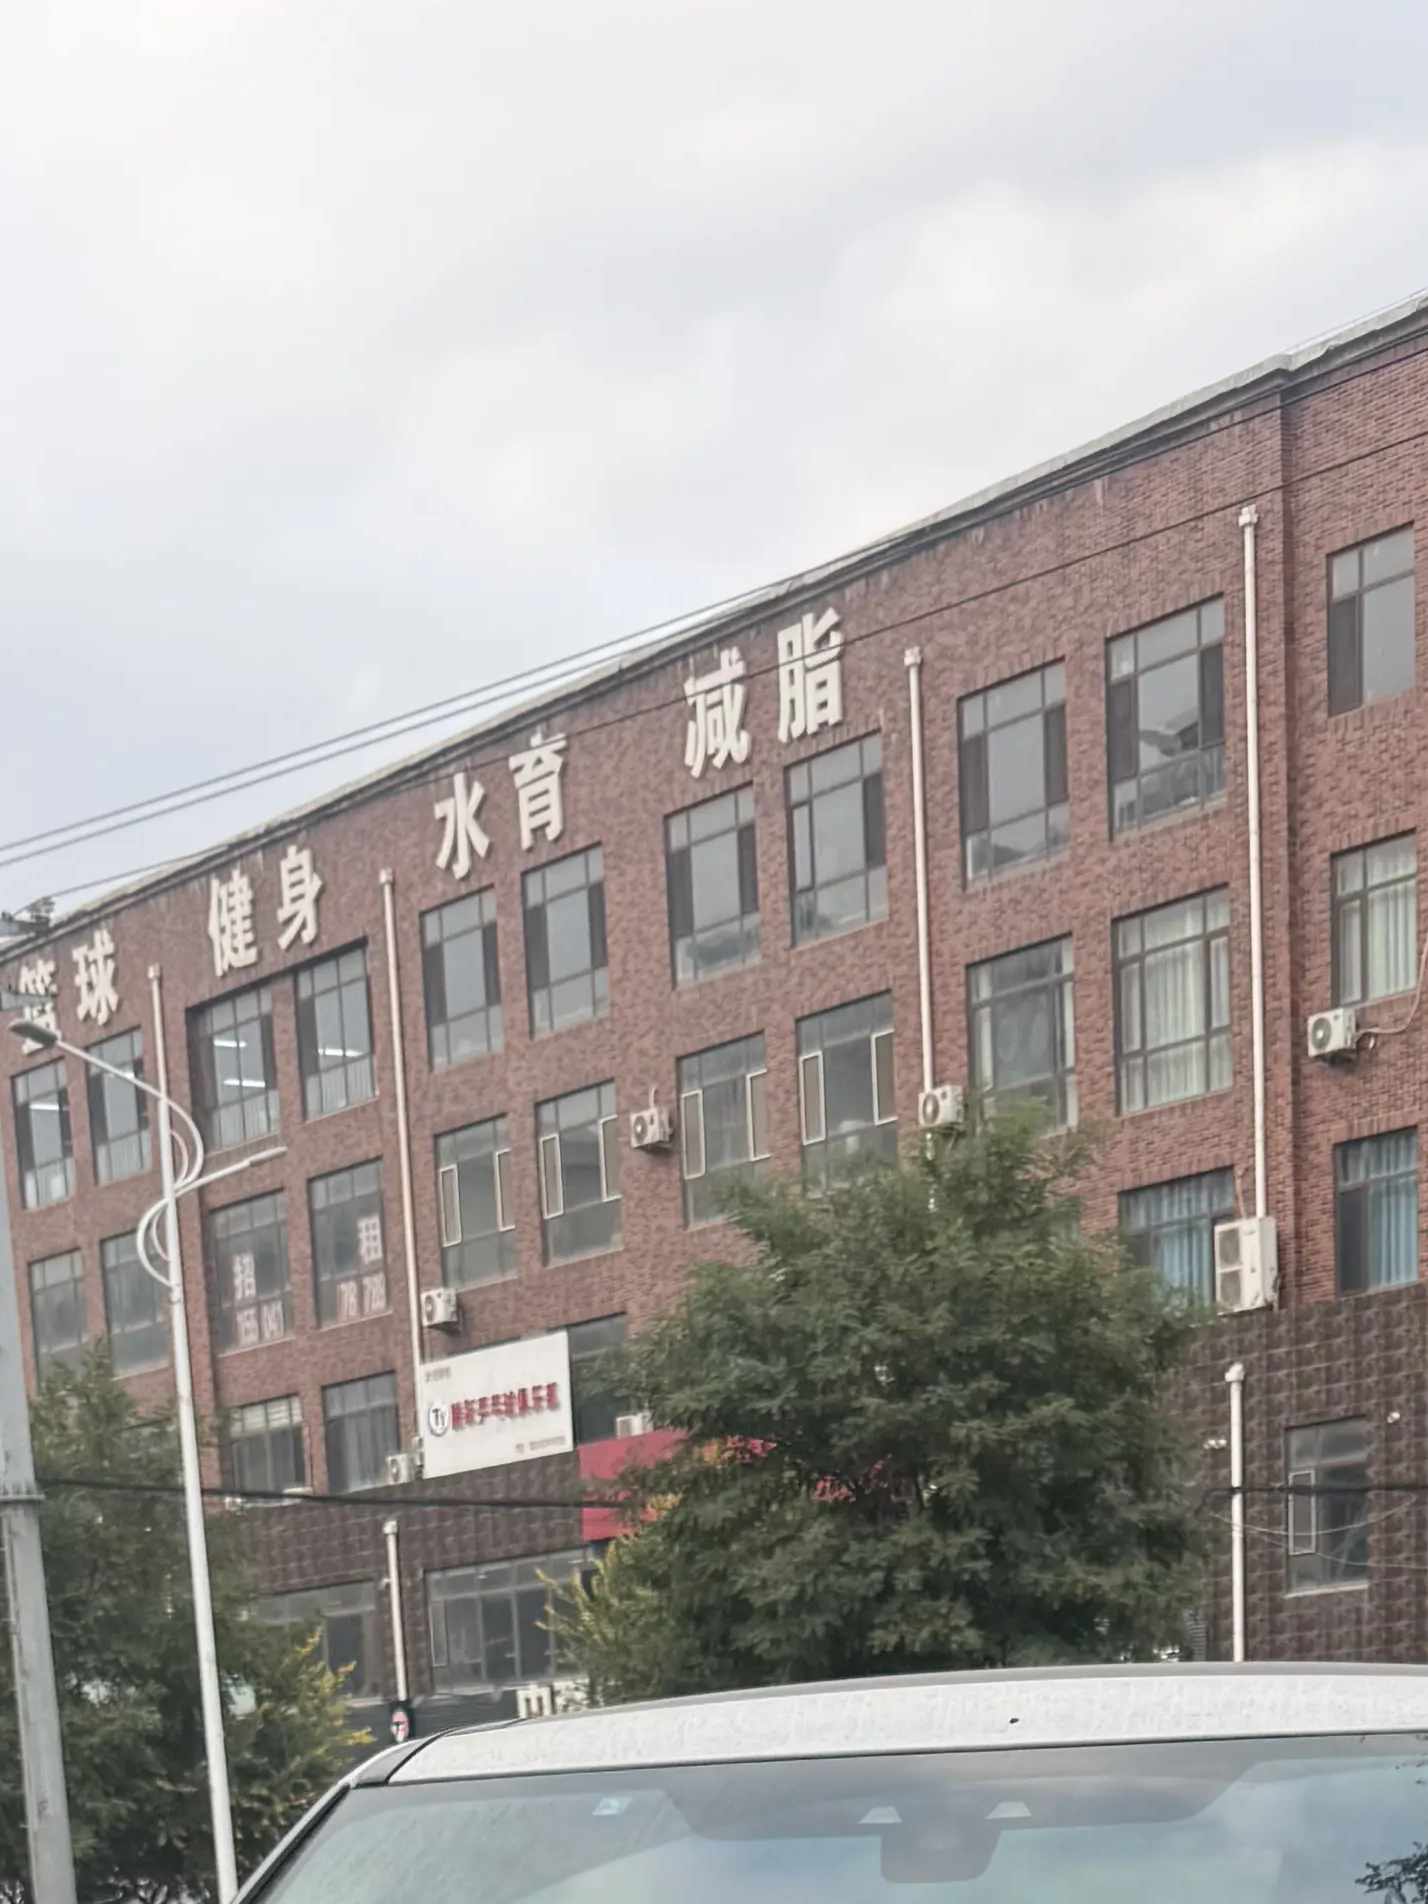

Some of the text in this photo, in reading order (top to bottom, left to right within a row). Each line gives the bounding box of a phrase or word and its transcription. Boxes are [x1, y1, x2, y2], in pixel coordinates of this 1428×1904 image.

[207, 845, 324, 978] 健身
[433, 732, 568, 880] 水育
[683, 608, 844, 779] 减脂
